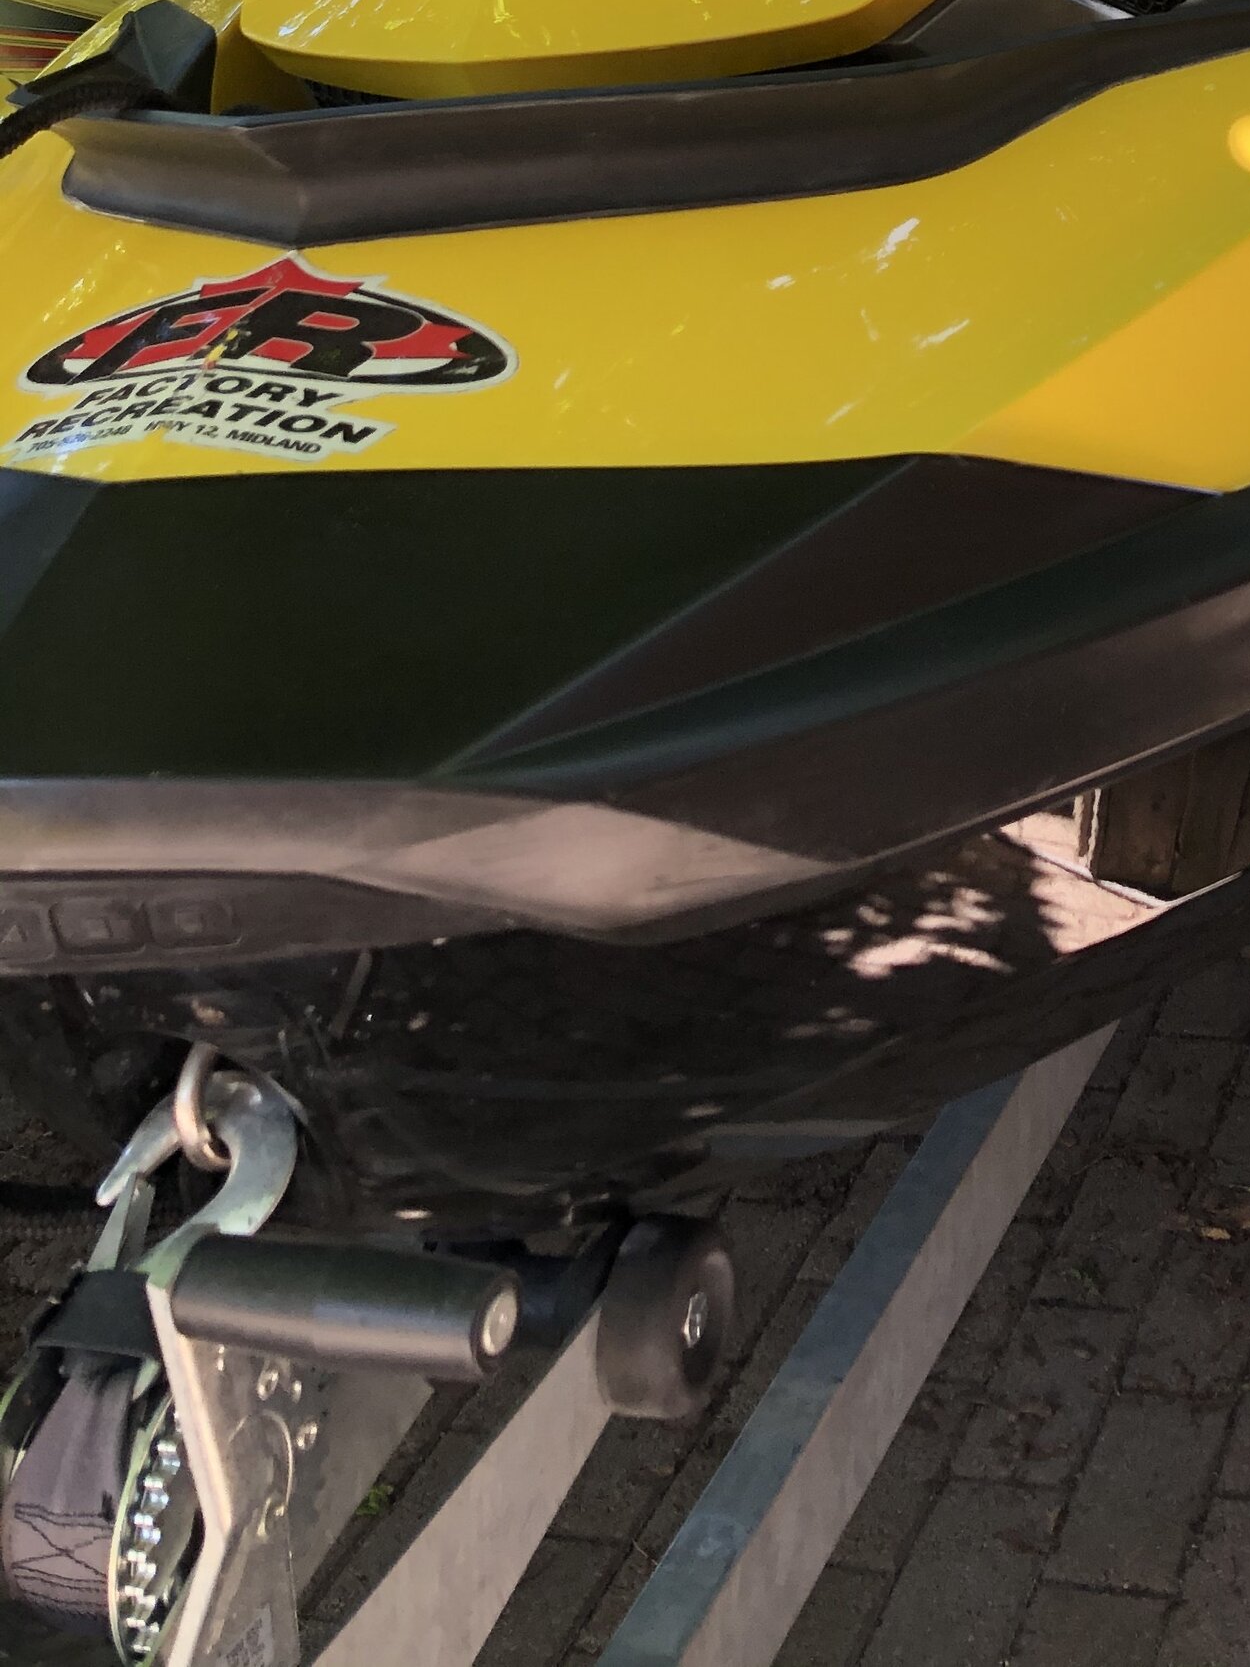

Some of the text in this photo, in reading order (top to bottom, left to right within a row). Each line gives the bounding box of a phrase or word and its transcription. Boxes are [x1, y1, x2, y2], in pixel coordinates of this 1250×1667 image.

[73, 372, 343, 411] FACTORY
[15, 396, 378, 444] RECREATION
[226, 429, 322, 454] MIDLAND
